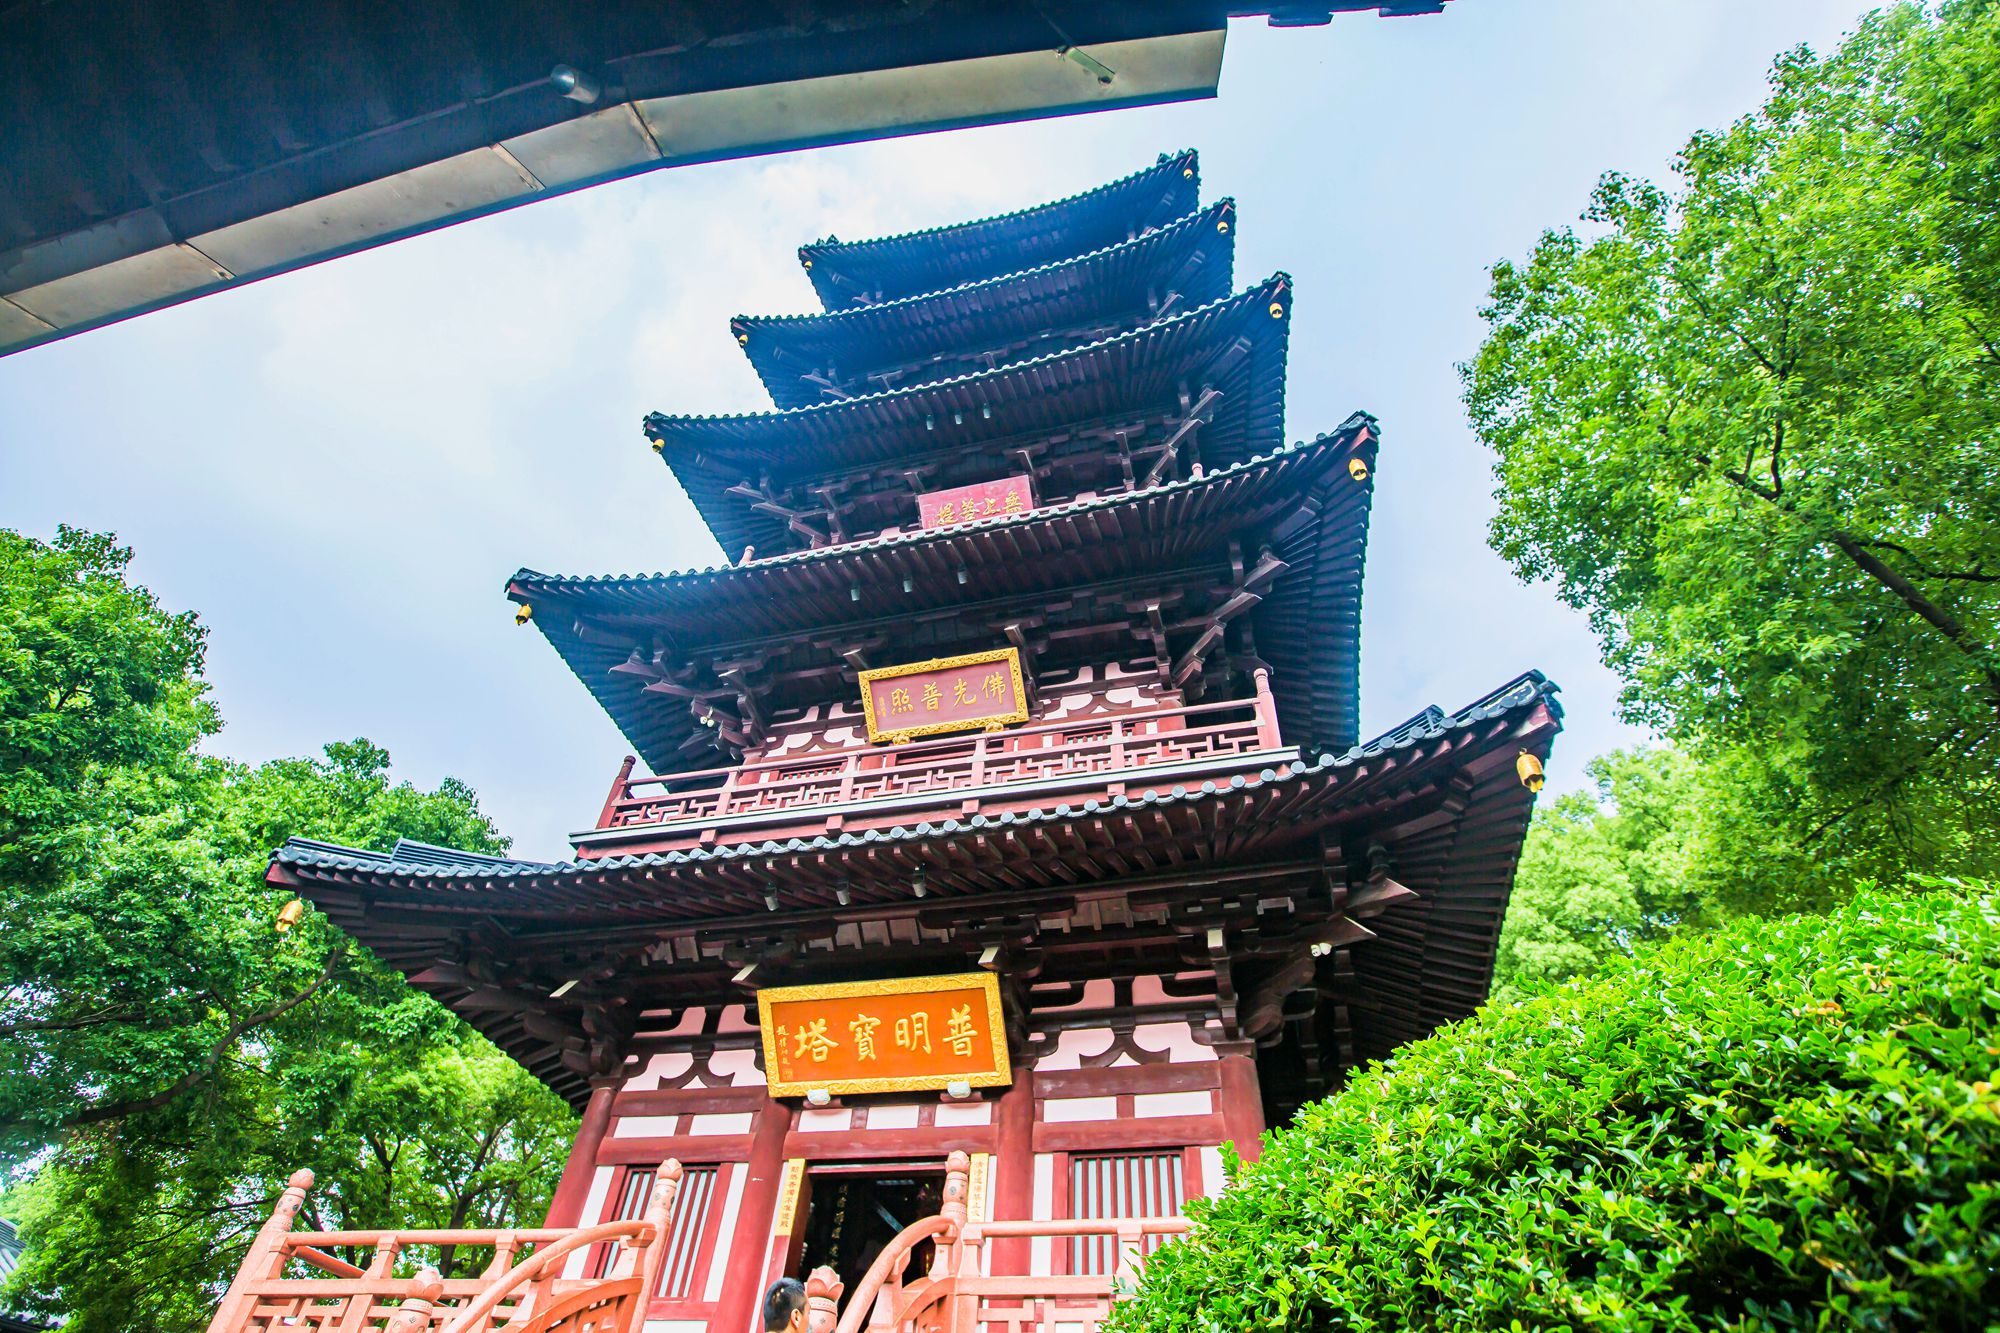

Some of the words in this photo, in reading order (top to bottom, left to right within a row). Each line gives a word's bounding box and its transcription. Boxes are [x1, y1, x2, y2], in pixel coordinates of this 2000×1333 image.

[891, 671, 1007, 716] 佛光普照
[794, 1003, 978, 1063] 普明寶塔
